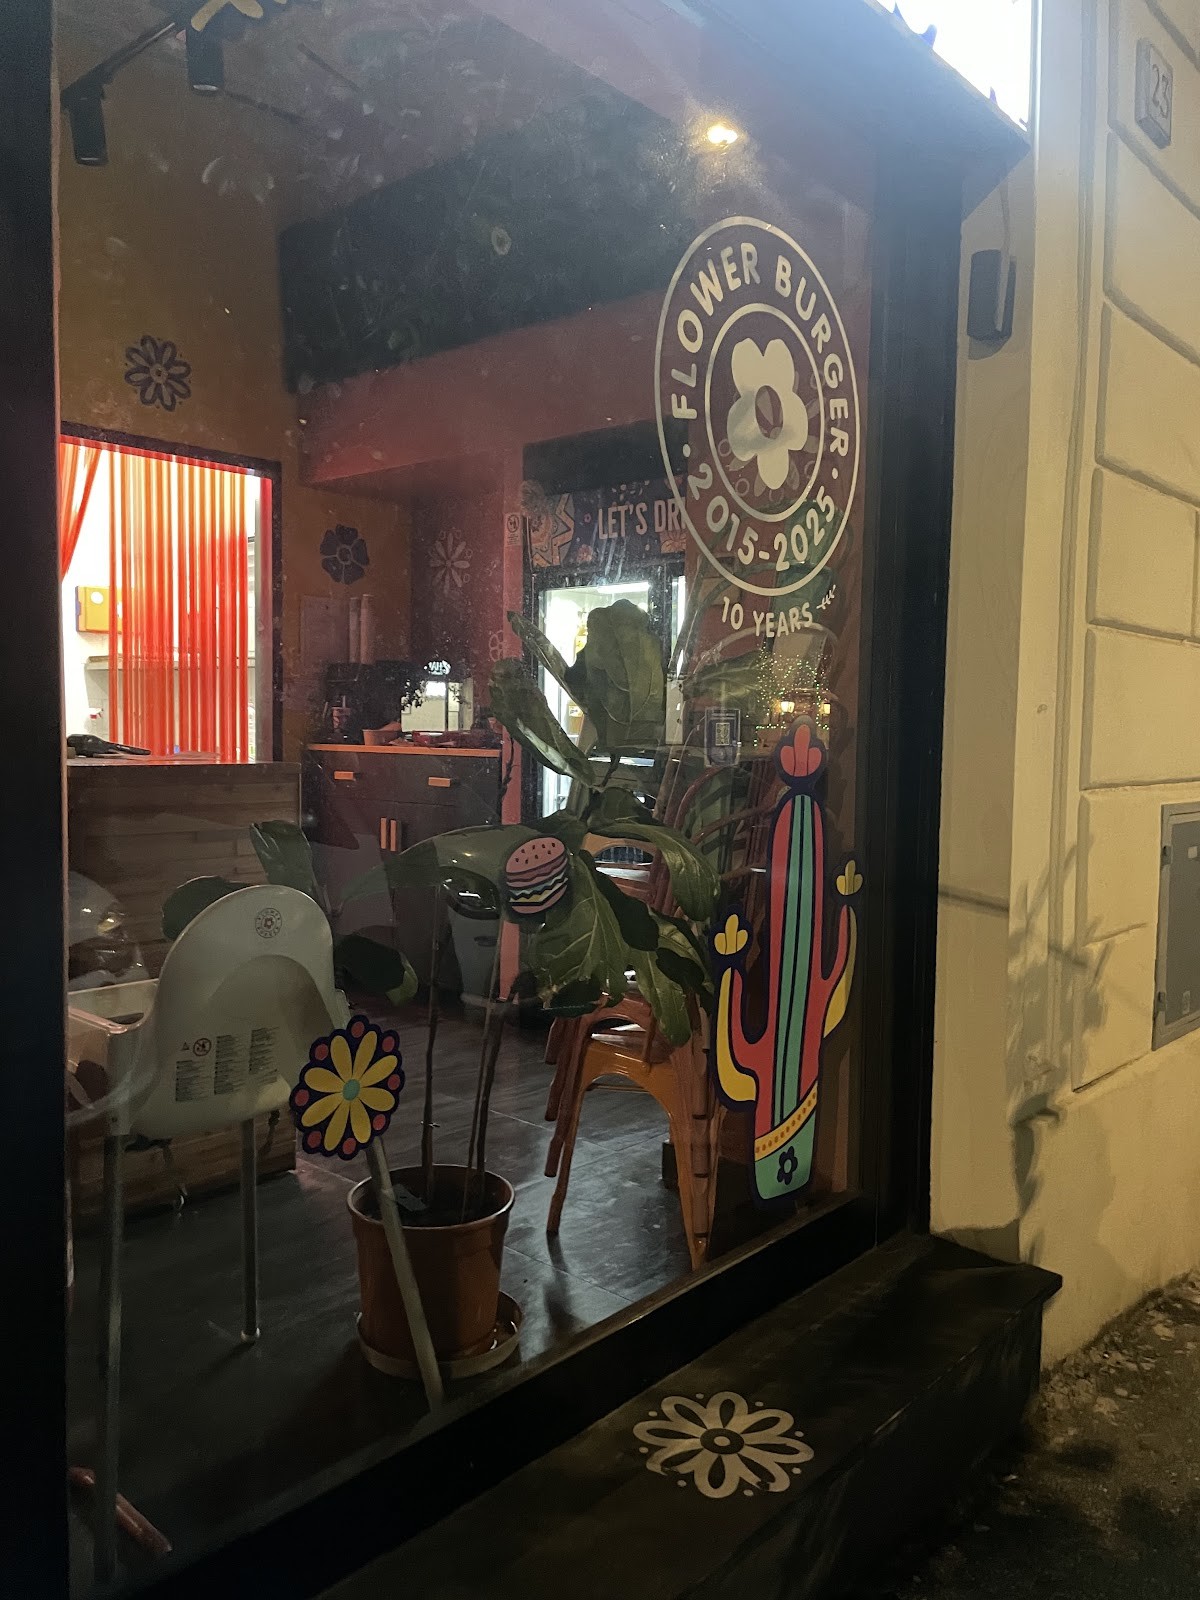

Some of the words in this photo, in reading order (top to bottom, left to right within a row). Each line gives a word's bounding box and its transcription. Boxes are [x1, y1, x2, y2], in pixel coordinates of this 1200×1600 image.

[1152, 63, 1169, 119] 23
[671, 242, 760, 419] FLOWER
[775, 255, 849, 457] BURGER
[598, 502, 648, 540] LET'S
[687, 463, 835, 571] 2015-2025
[722, 596, 744, 630] 10
[753, 602, 813, 638] YEARS
